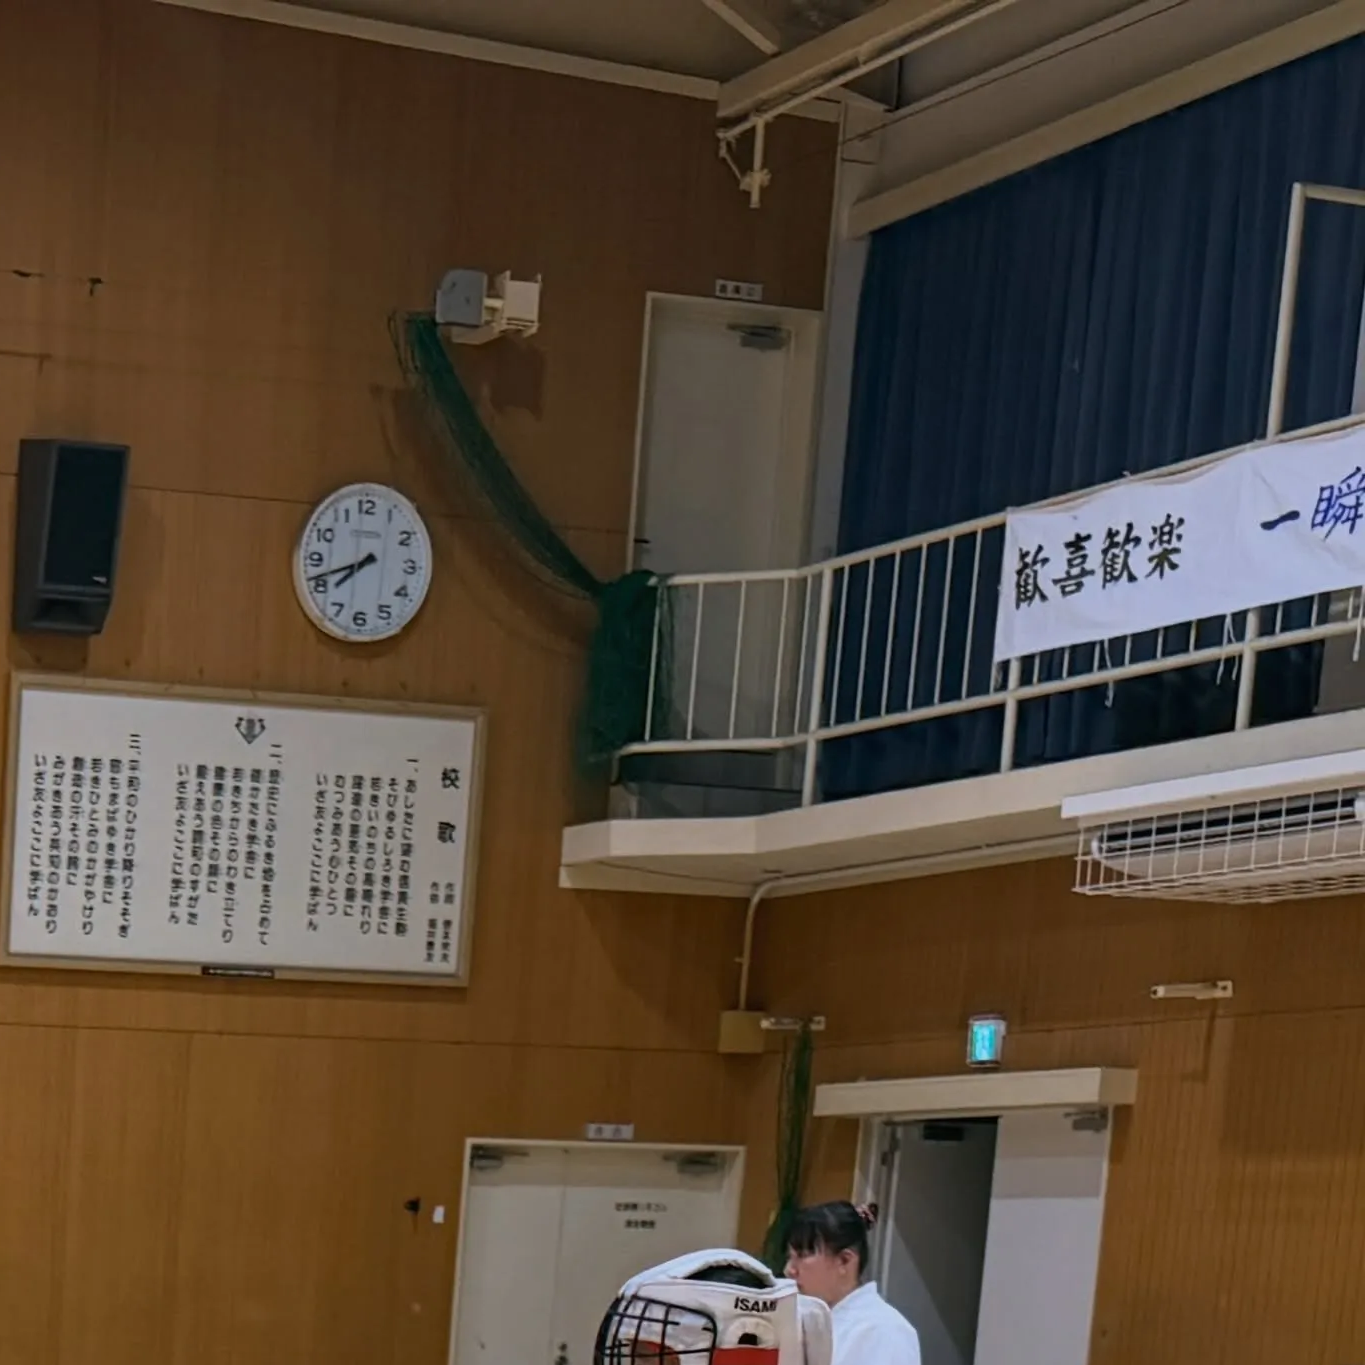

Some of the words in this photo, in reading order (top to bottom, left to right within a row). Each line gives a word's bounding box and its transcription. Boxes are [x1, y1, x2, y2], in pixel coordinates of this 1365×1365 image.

[334, 507, 350, 523] 11
[358, 500, 376, 515] 12
[316, 528, 335, 543] 10
[398, 531, 412, 546] 2
[309, 552, 323, 567] 9
[403, 559, 417, 575] 3
[1014, 513, 1186, 611] 歓喜歓楽
[313, 578, 328, 594] 8
[393, 585, 409, 597] 4
[331, 602, 344, 618] 7
[378, 604, 392, 620] 5
[353, 611, 367, 627] 6
